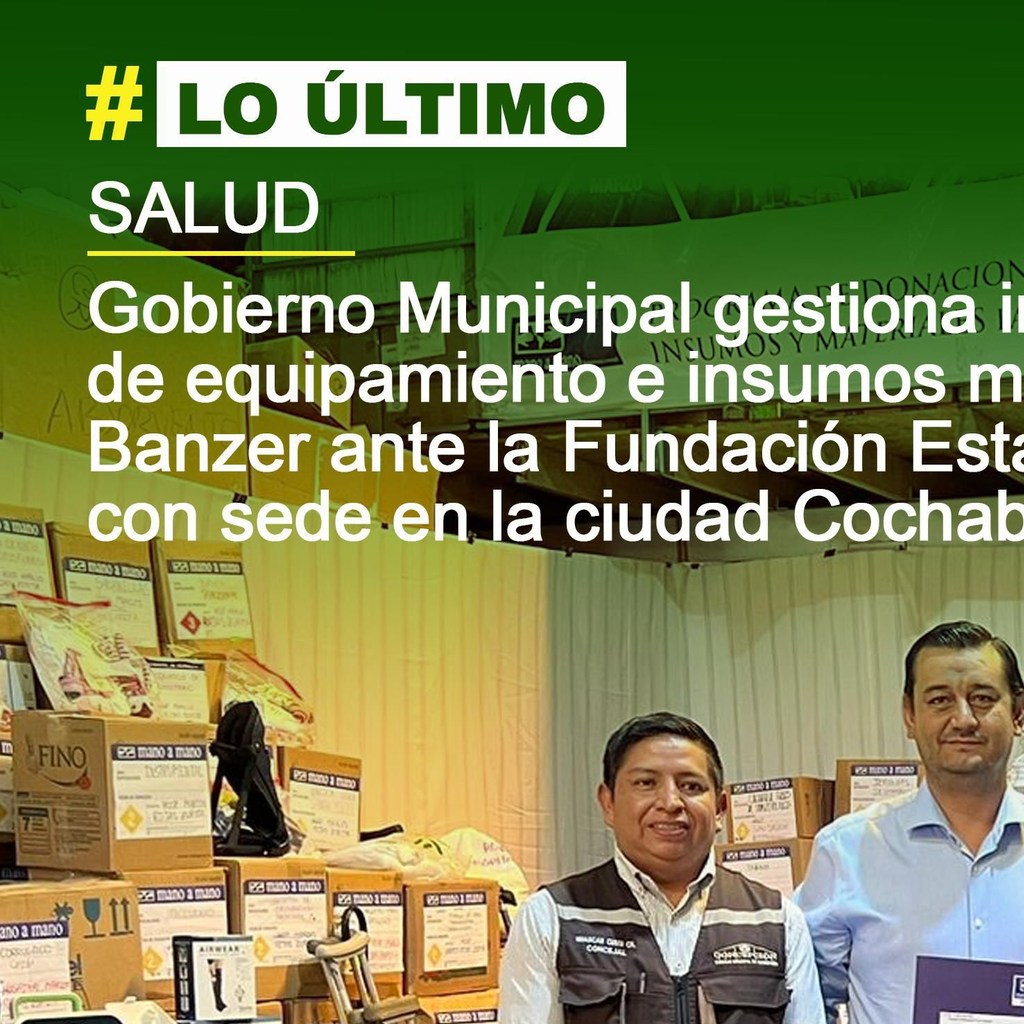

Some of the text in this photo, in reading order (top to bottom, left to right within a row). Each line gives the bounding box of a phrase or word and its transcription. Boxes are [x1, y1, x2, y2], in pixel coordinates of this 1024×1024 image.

[650, 331, 783, 364] INSUMOS
[38, 745, 87, 769] FINO
[137, 746, 203, 759] mano a mano
[157, 887, 222, 902] mano a mano
[0, 922, 64, 939] ano a mano
